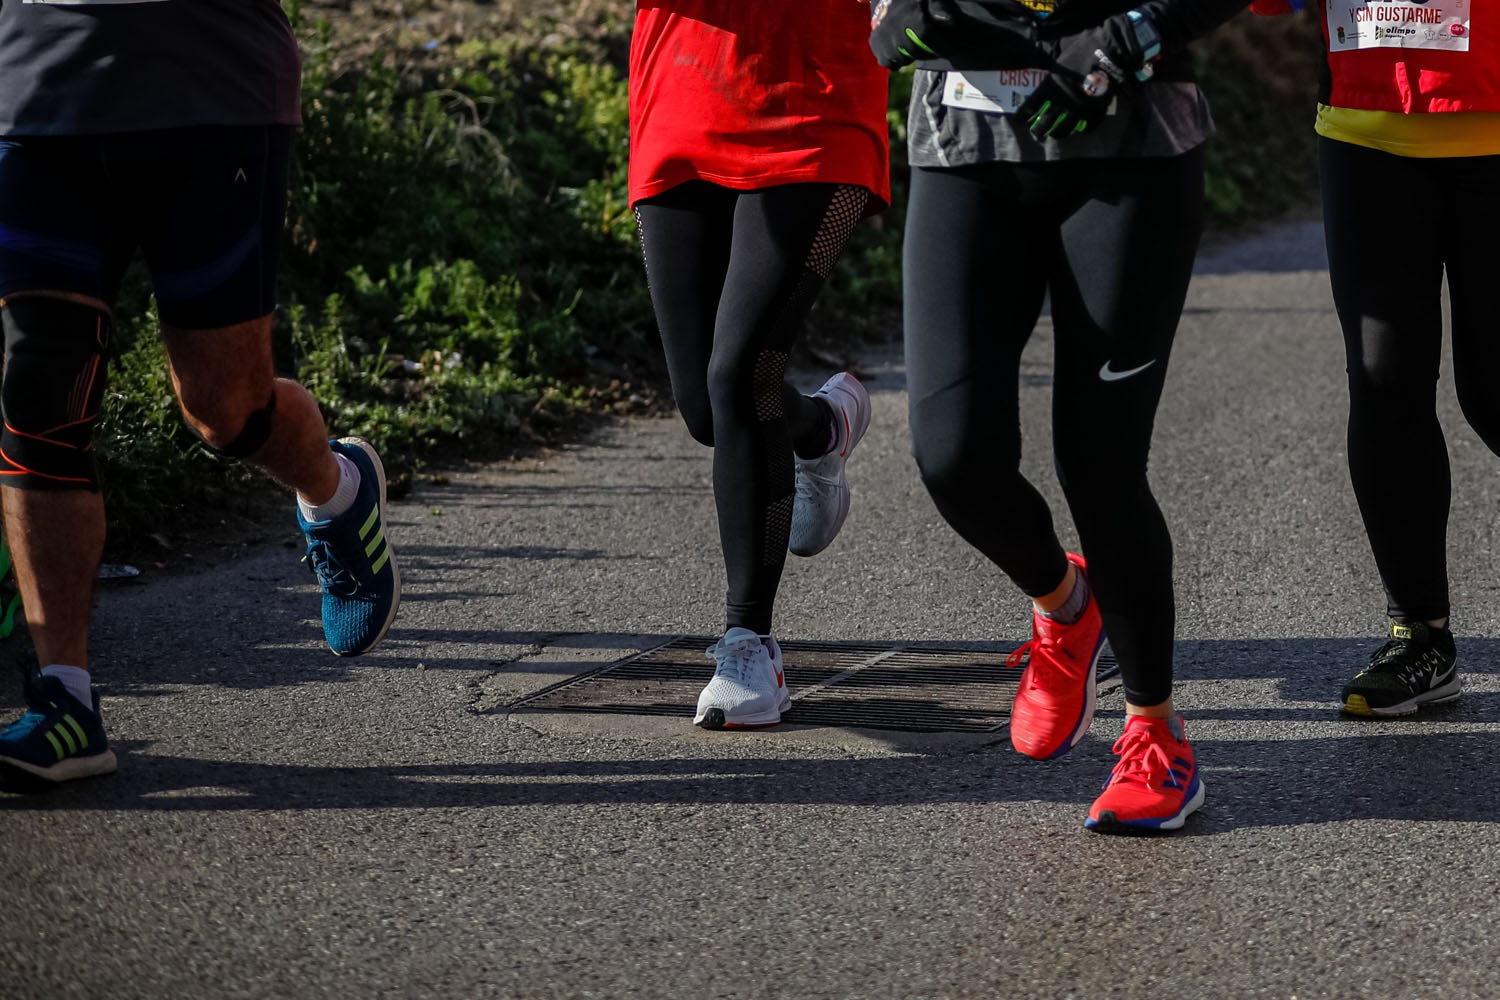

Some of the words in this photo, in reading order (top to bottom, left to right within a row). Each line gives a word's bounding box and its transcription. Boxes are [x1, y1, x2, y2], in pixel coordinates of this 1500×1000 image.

[1349, 8, 1355, 23] Y
[1357, 6, 1373, 22] SIN
[1377, 6, 1442, 24] GUSTARME
[1386, 26, 1416, 36] olimpo
[1000, 68, 1050, 88] CRISTI
